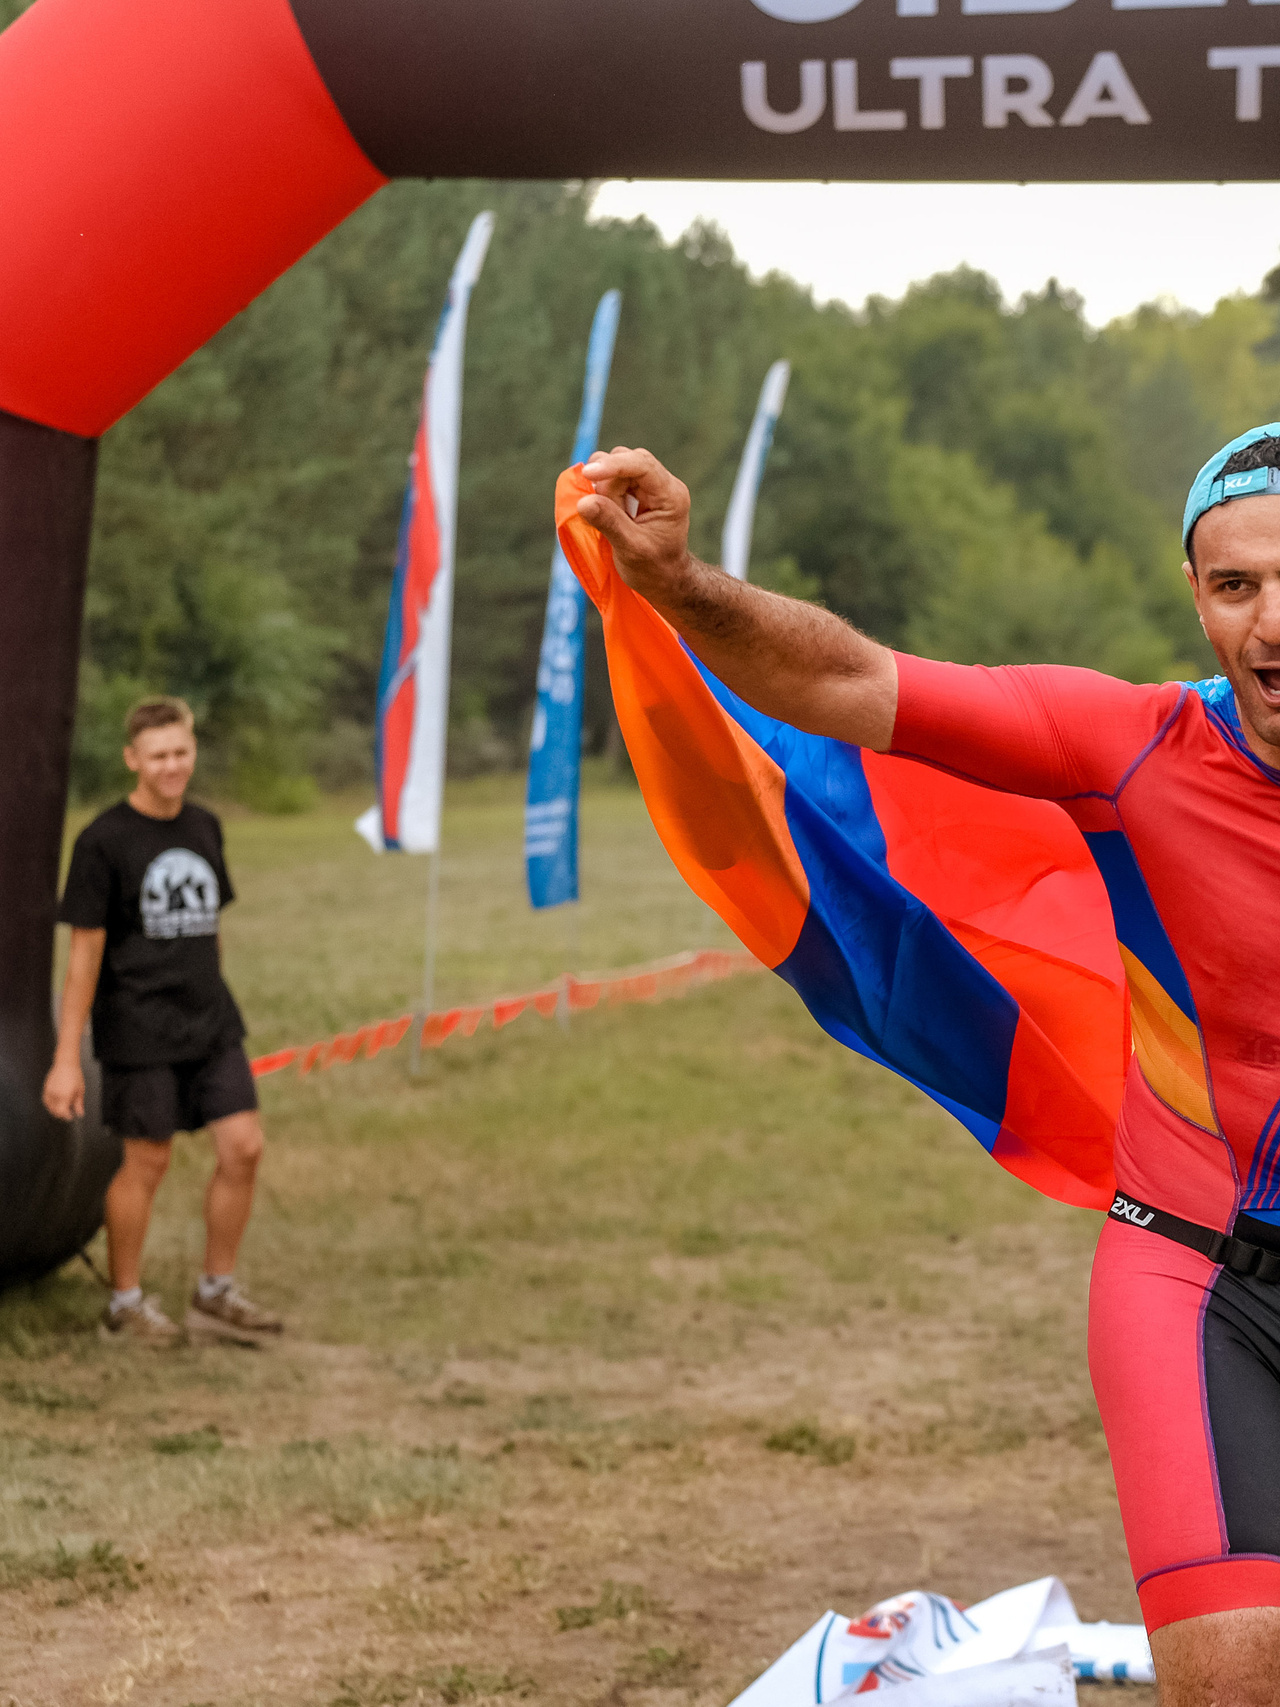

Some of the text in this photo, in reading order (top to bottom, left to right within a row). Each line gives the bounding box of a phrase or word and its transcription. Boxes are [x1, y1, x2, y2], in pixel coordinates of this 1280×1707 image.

[740, 50, 1153, 135] ULTRA
[1223, 475, 1253, 491] XU
[1110, 1196, 1155, 1227] 2XU
